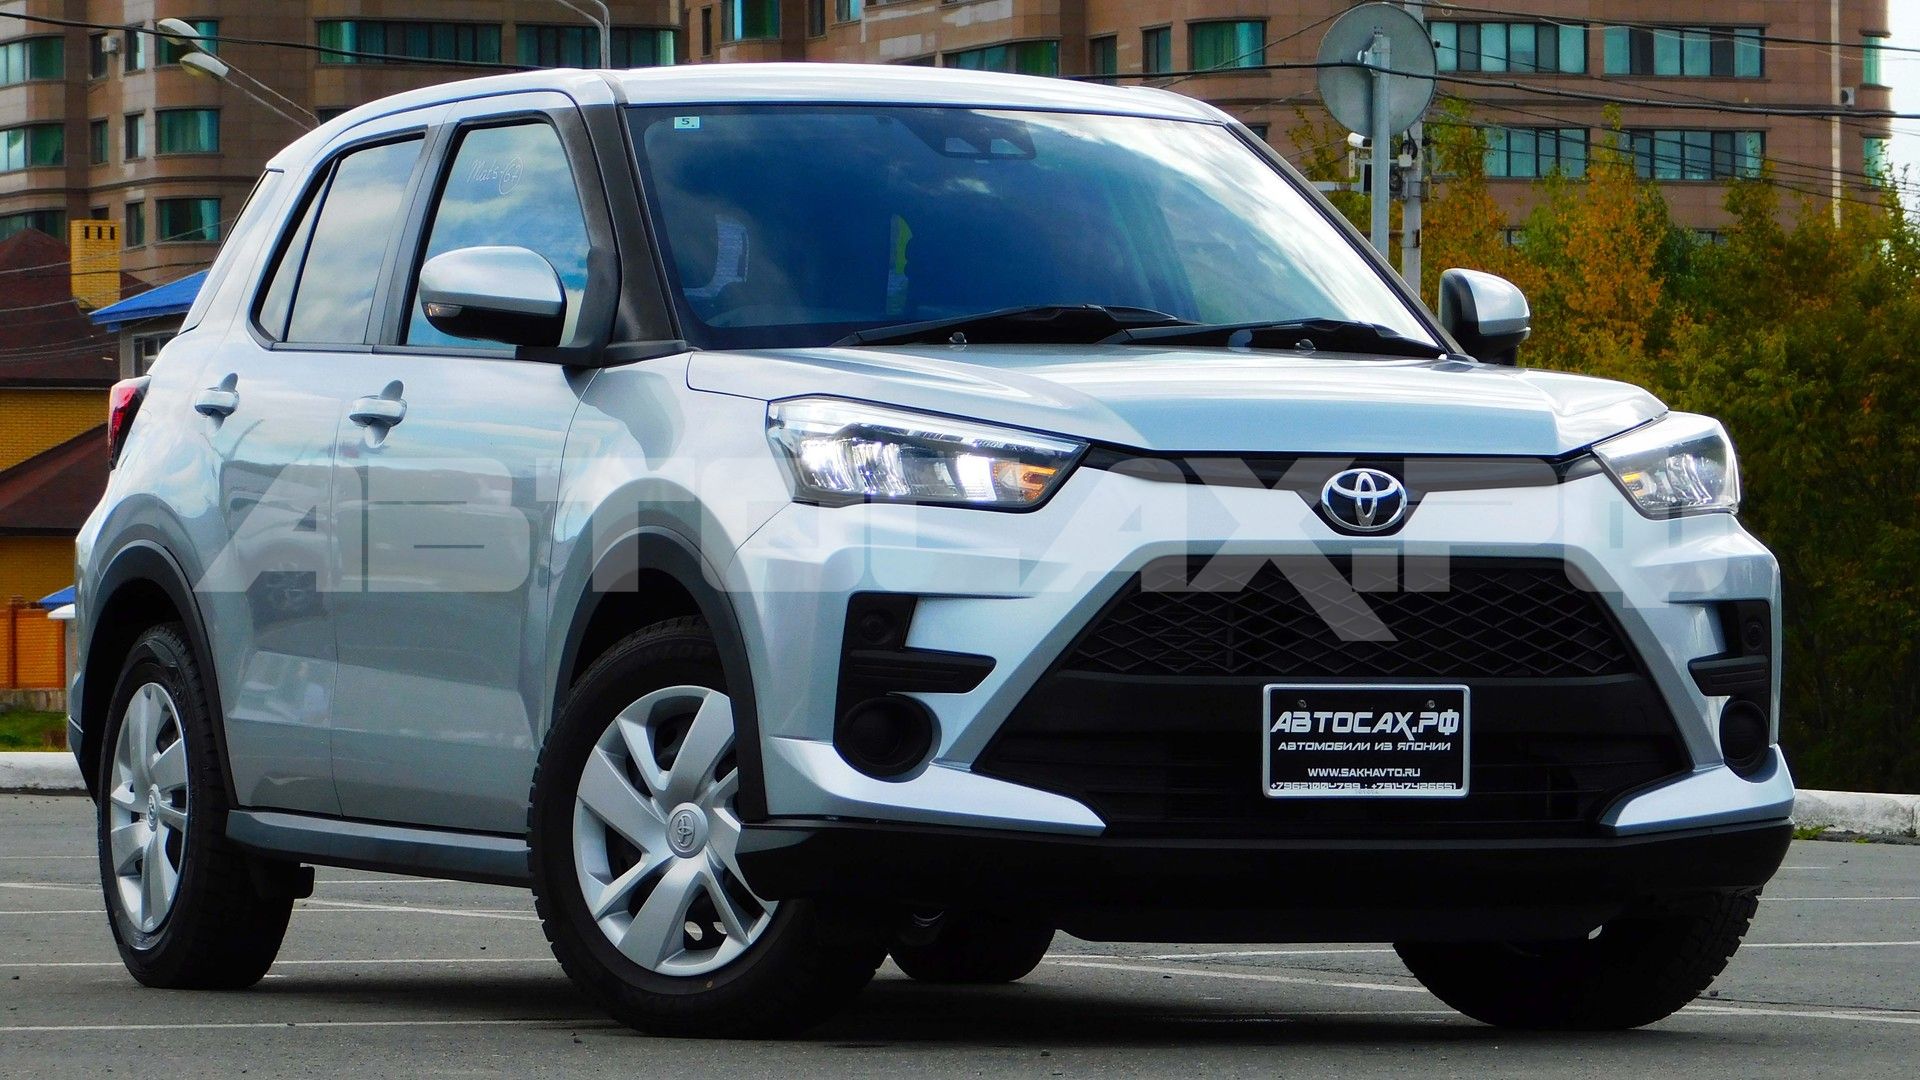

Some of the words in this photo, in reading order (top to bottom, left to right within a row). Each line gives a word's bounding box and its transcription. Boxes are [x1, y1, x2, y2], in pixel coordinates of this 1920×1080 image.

[1270, 709, 1460, 741] АВТОСАХ.РФ
[1278, 742, 1371, 751] АВТОМОБИЛИ
[1374, 742, 1393, 751] ИЗ
[1397, 742, 1451, 751] ЯПОНИИ
[1307, 768, 1421, 777] WWW.SAKHAVTO.RU
